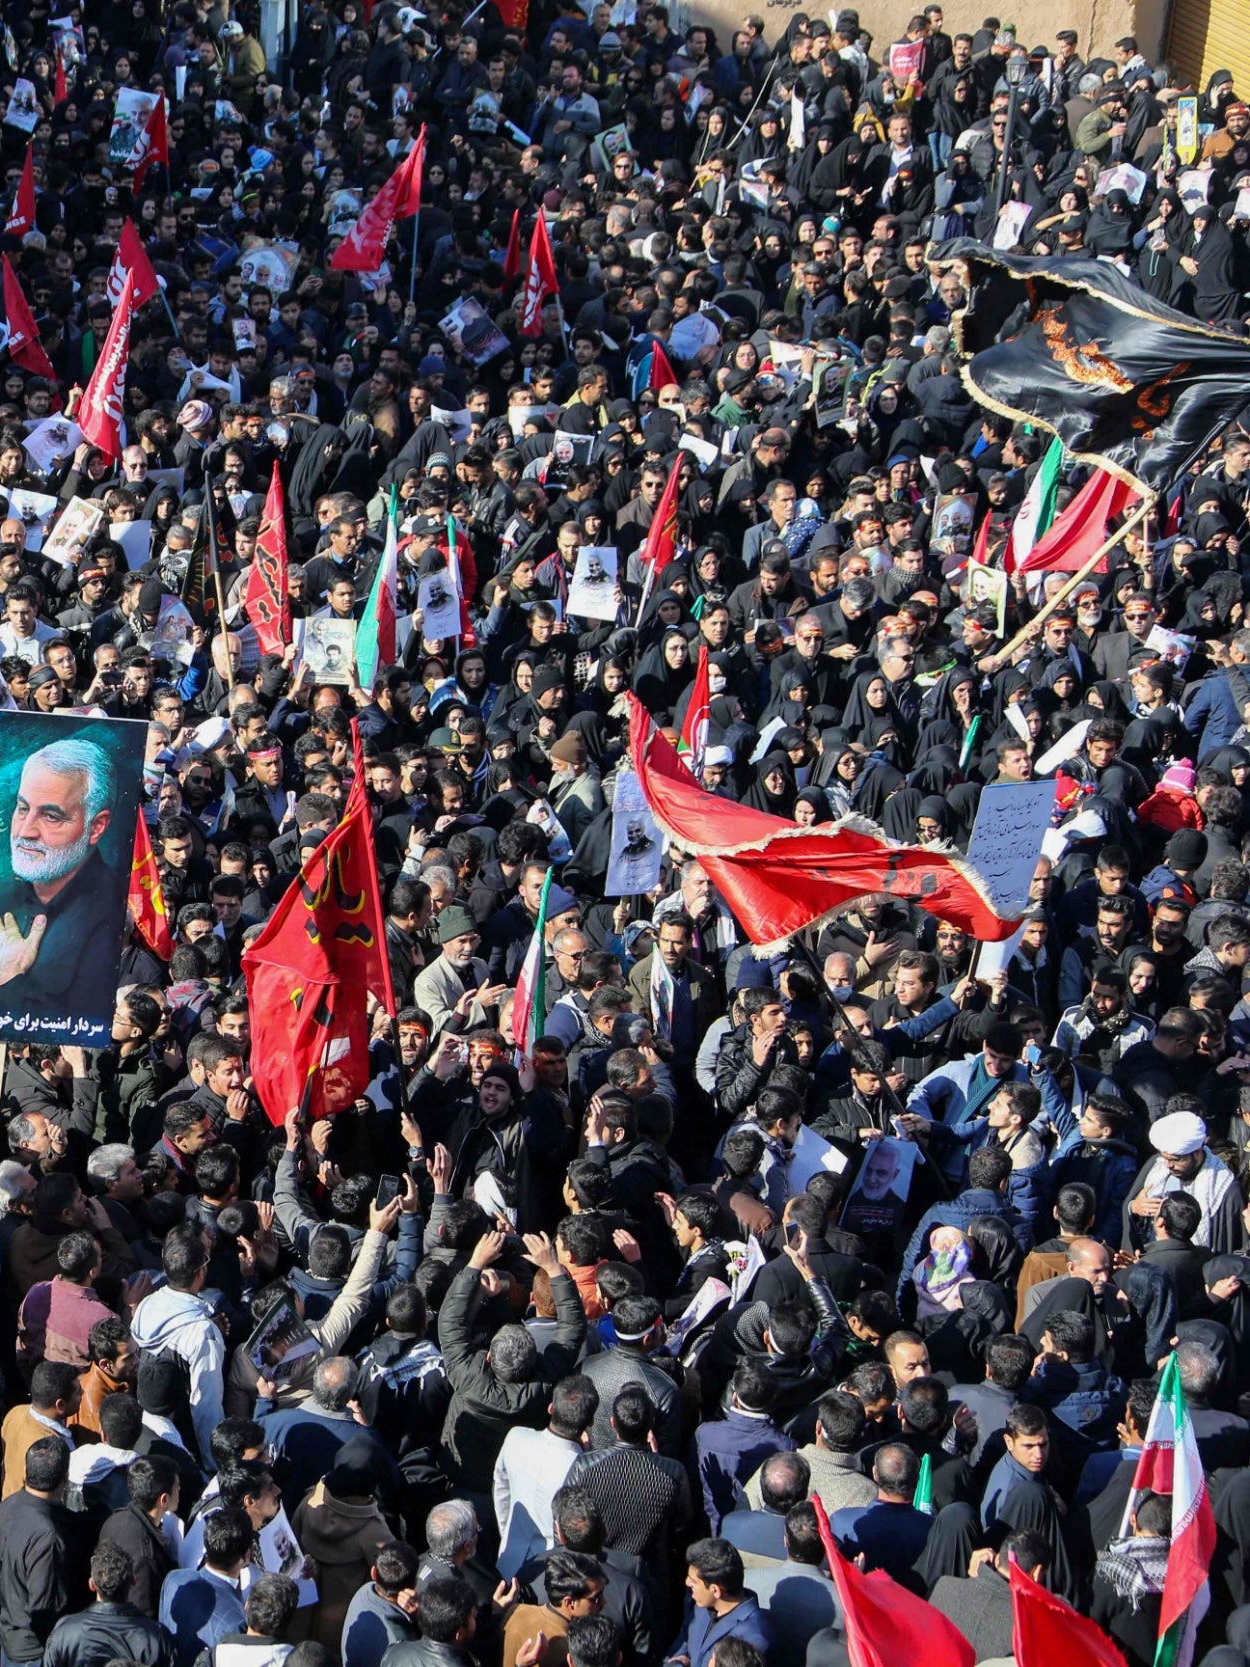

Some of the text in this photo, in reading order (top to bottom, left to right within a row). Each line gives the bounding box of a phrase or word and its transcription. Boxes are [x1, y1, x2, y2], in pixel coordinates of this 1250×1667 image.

[14, 1012, 40, 1032] برای
[40, 1015, 71, 1031] امنیت
[71, 1016, 104, 1037] سردار
